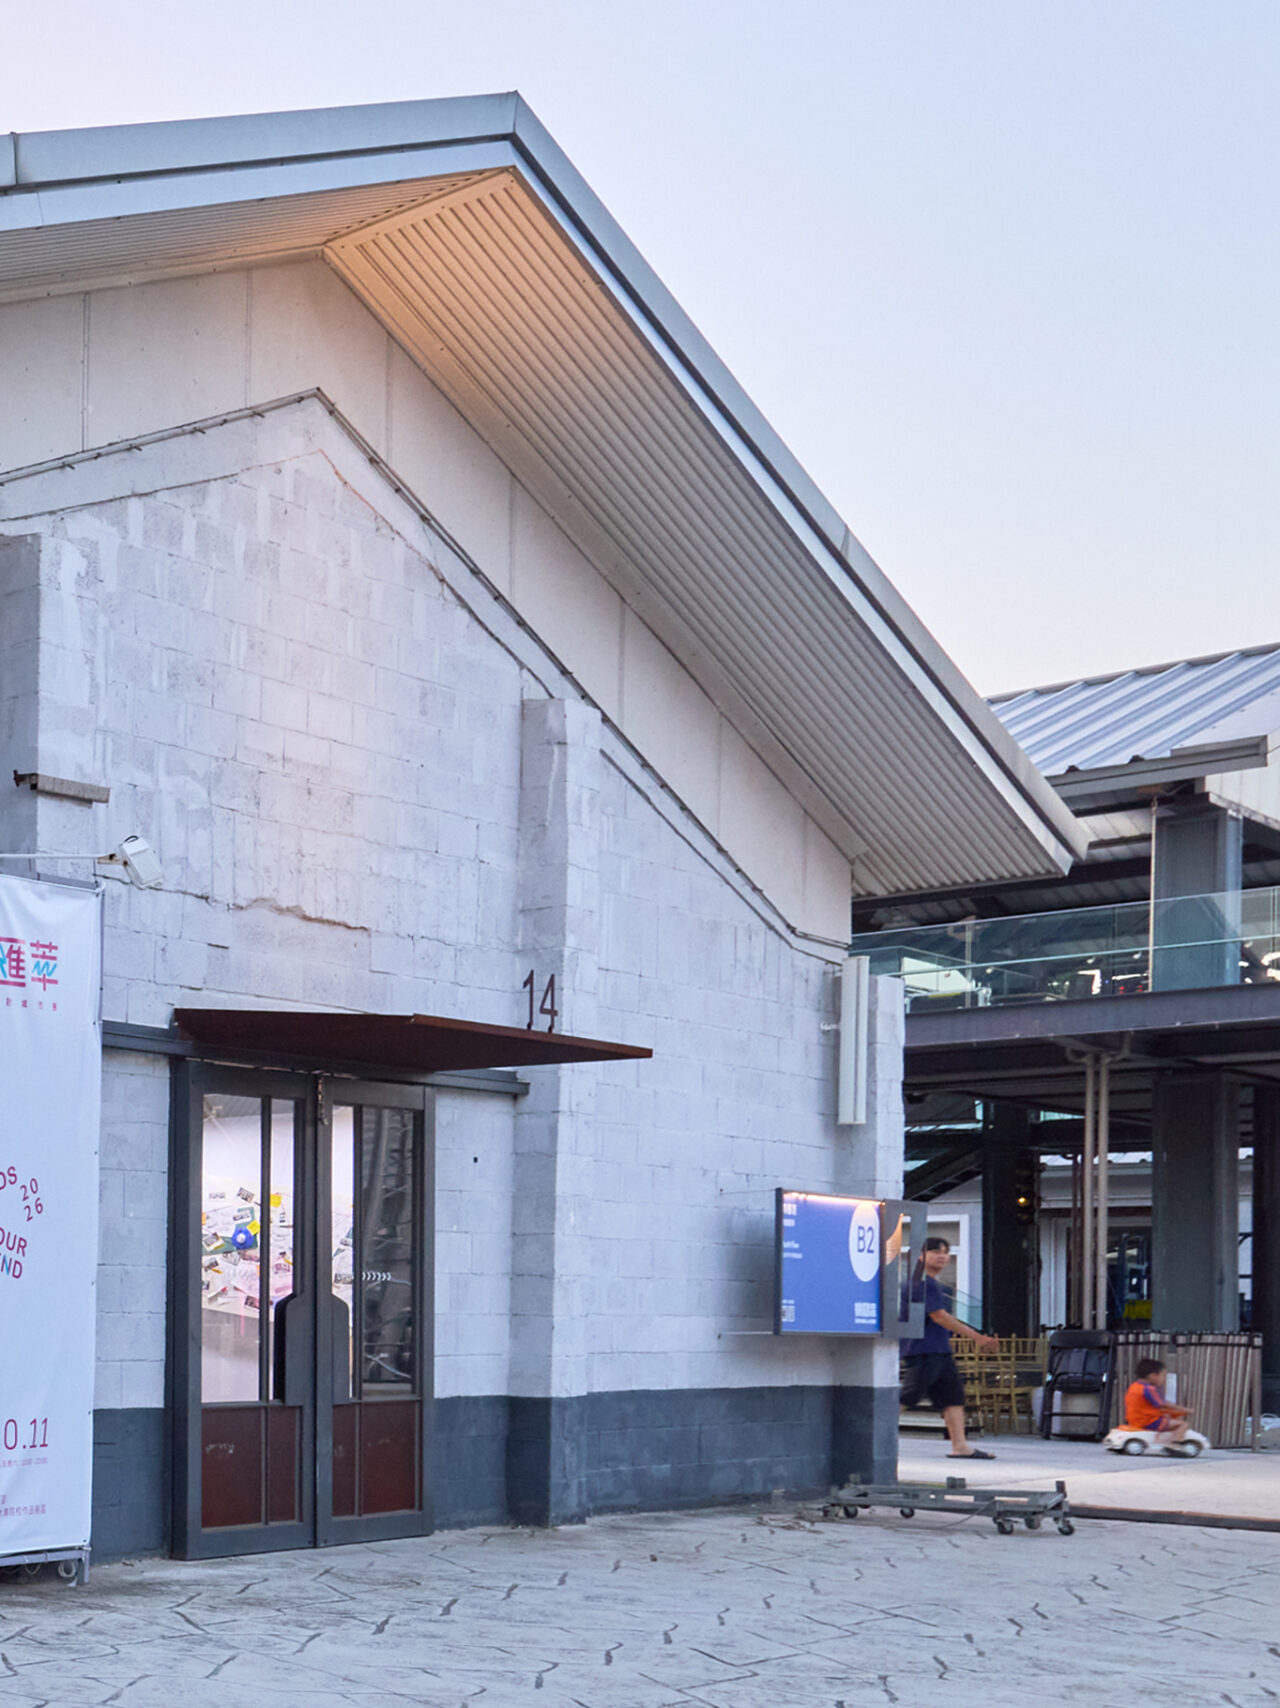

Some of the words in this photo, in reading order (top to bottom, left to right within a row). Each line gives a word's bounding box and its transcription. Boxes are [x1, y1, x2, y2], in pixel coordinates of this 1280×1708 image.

[523, 968, 559, 1031] 14
[20, 1177, 39, 1202] 20
[24, 1197, 44, 1222] 26
[856, 1225, 876, 1254] B2
